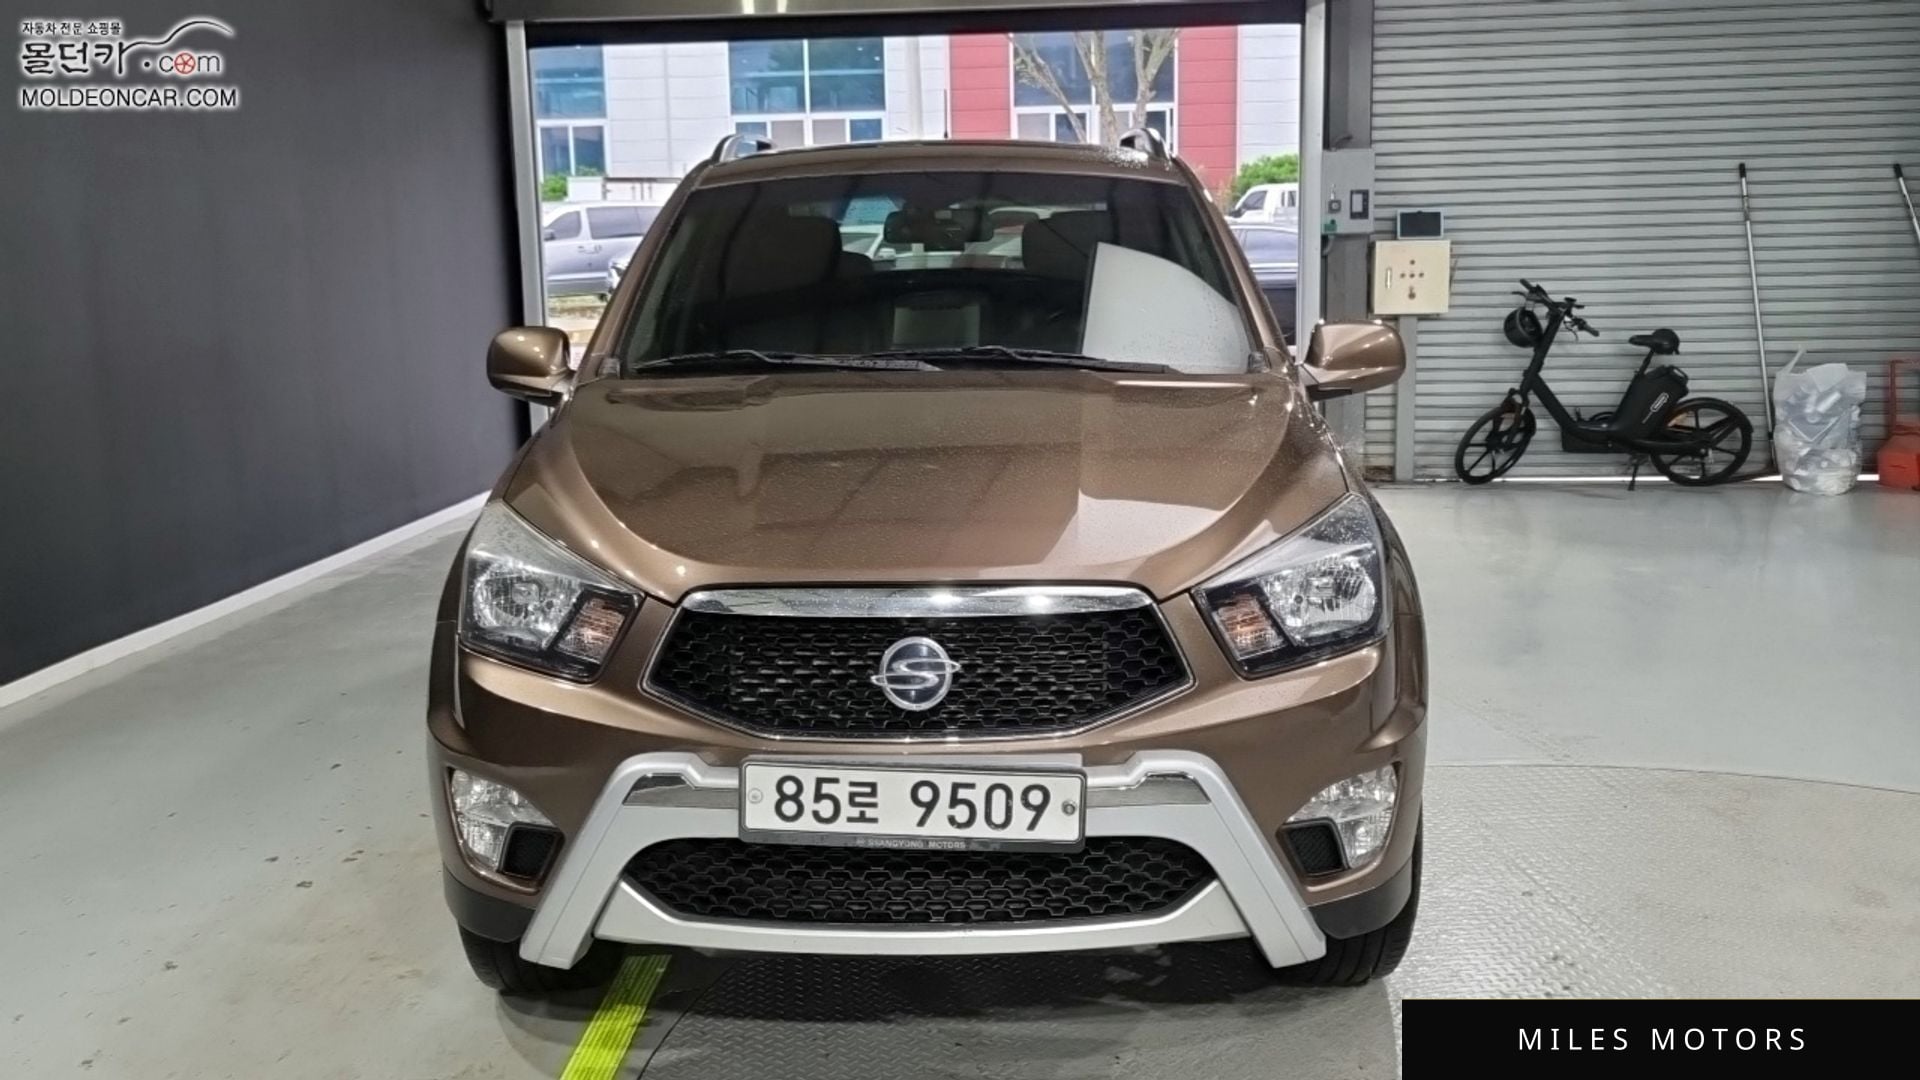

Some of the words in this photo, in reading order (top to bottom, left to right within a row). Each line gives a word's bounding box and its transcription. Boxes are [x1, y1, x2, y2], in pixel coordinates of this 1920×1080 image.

[774, 775, 879, 825] 85로
[910, 780, 1051, 832] 9509
[928, 840, 967, 849] MOTORS
